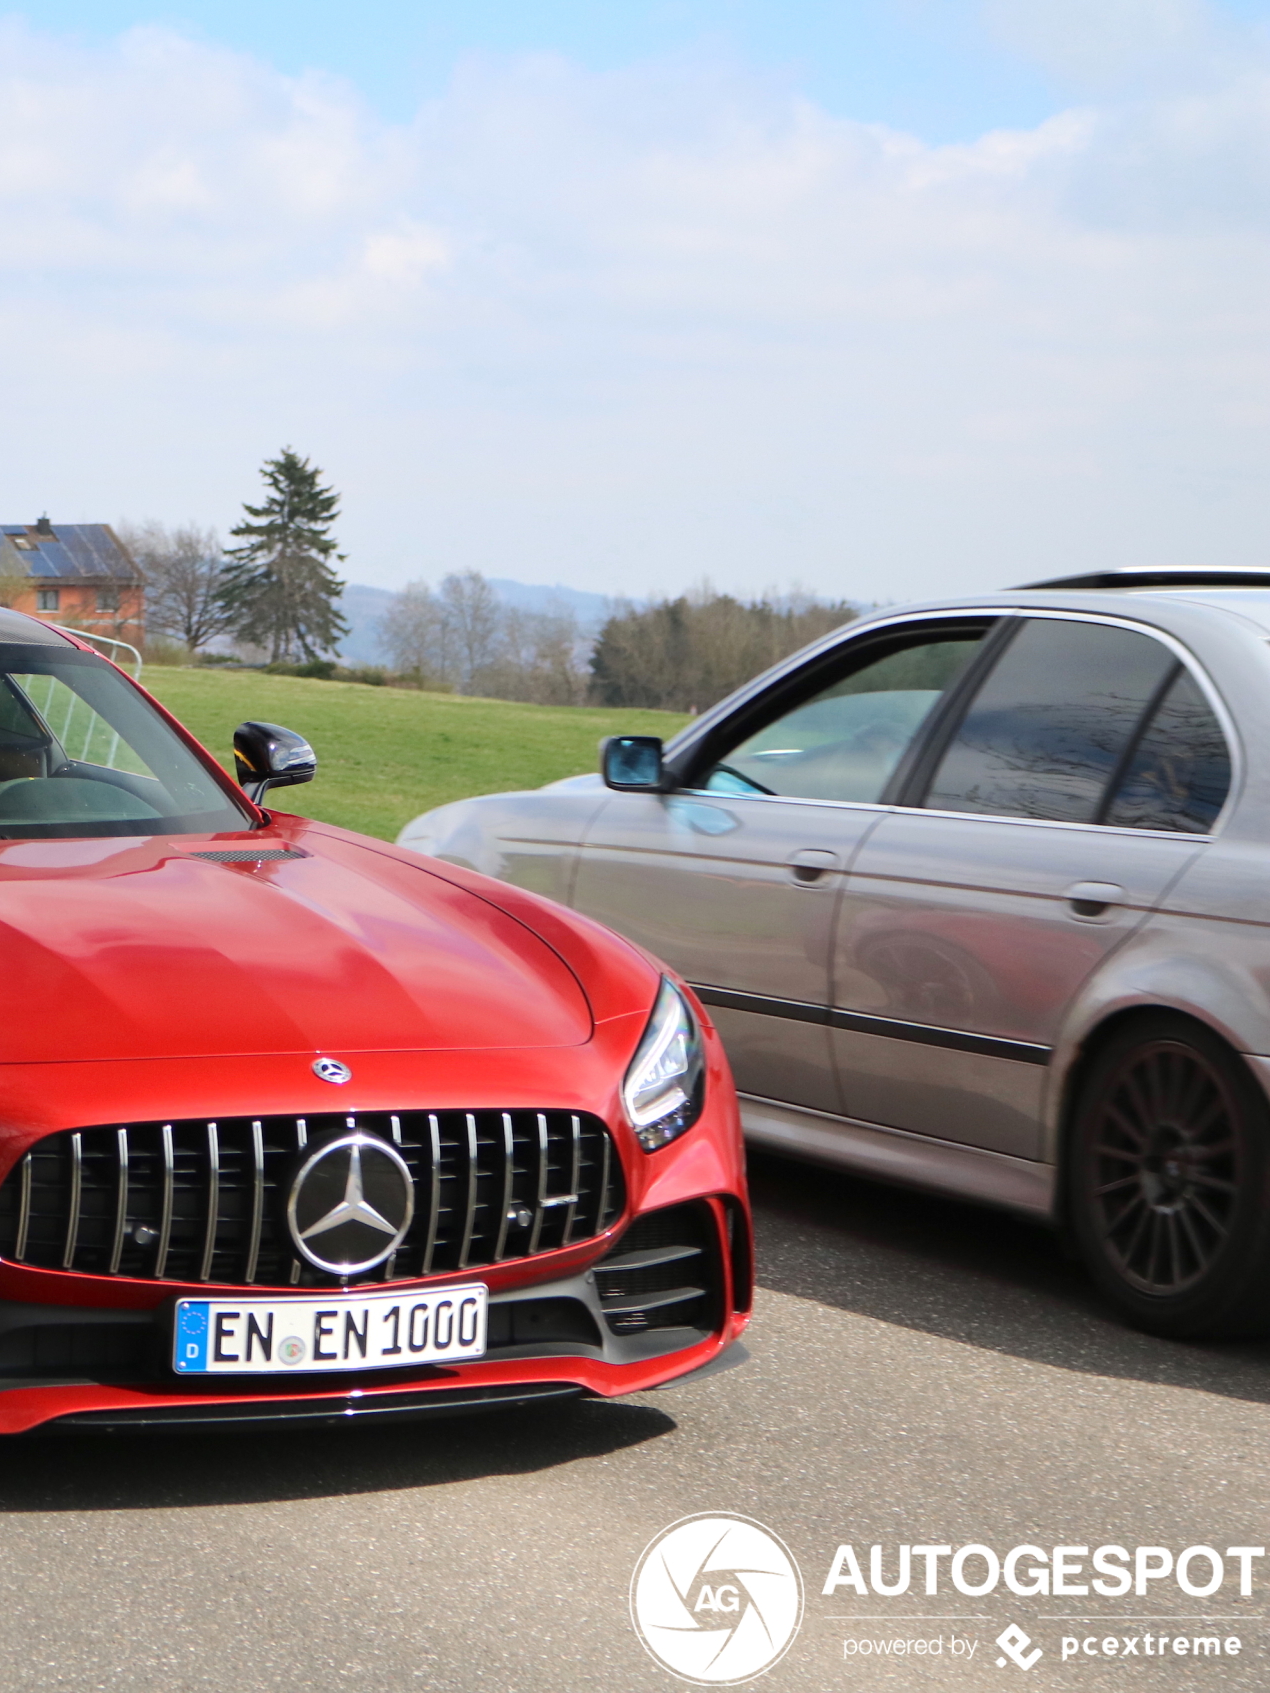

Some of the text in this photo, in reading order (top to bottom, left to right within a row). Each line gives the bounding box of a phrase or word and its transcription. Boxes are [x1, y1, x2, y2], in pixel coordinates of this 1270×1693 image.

[213, 1297, 478, 1362] EN EN 1000
[186, 1343, 199, 1359] D
